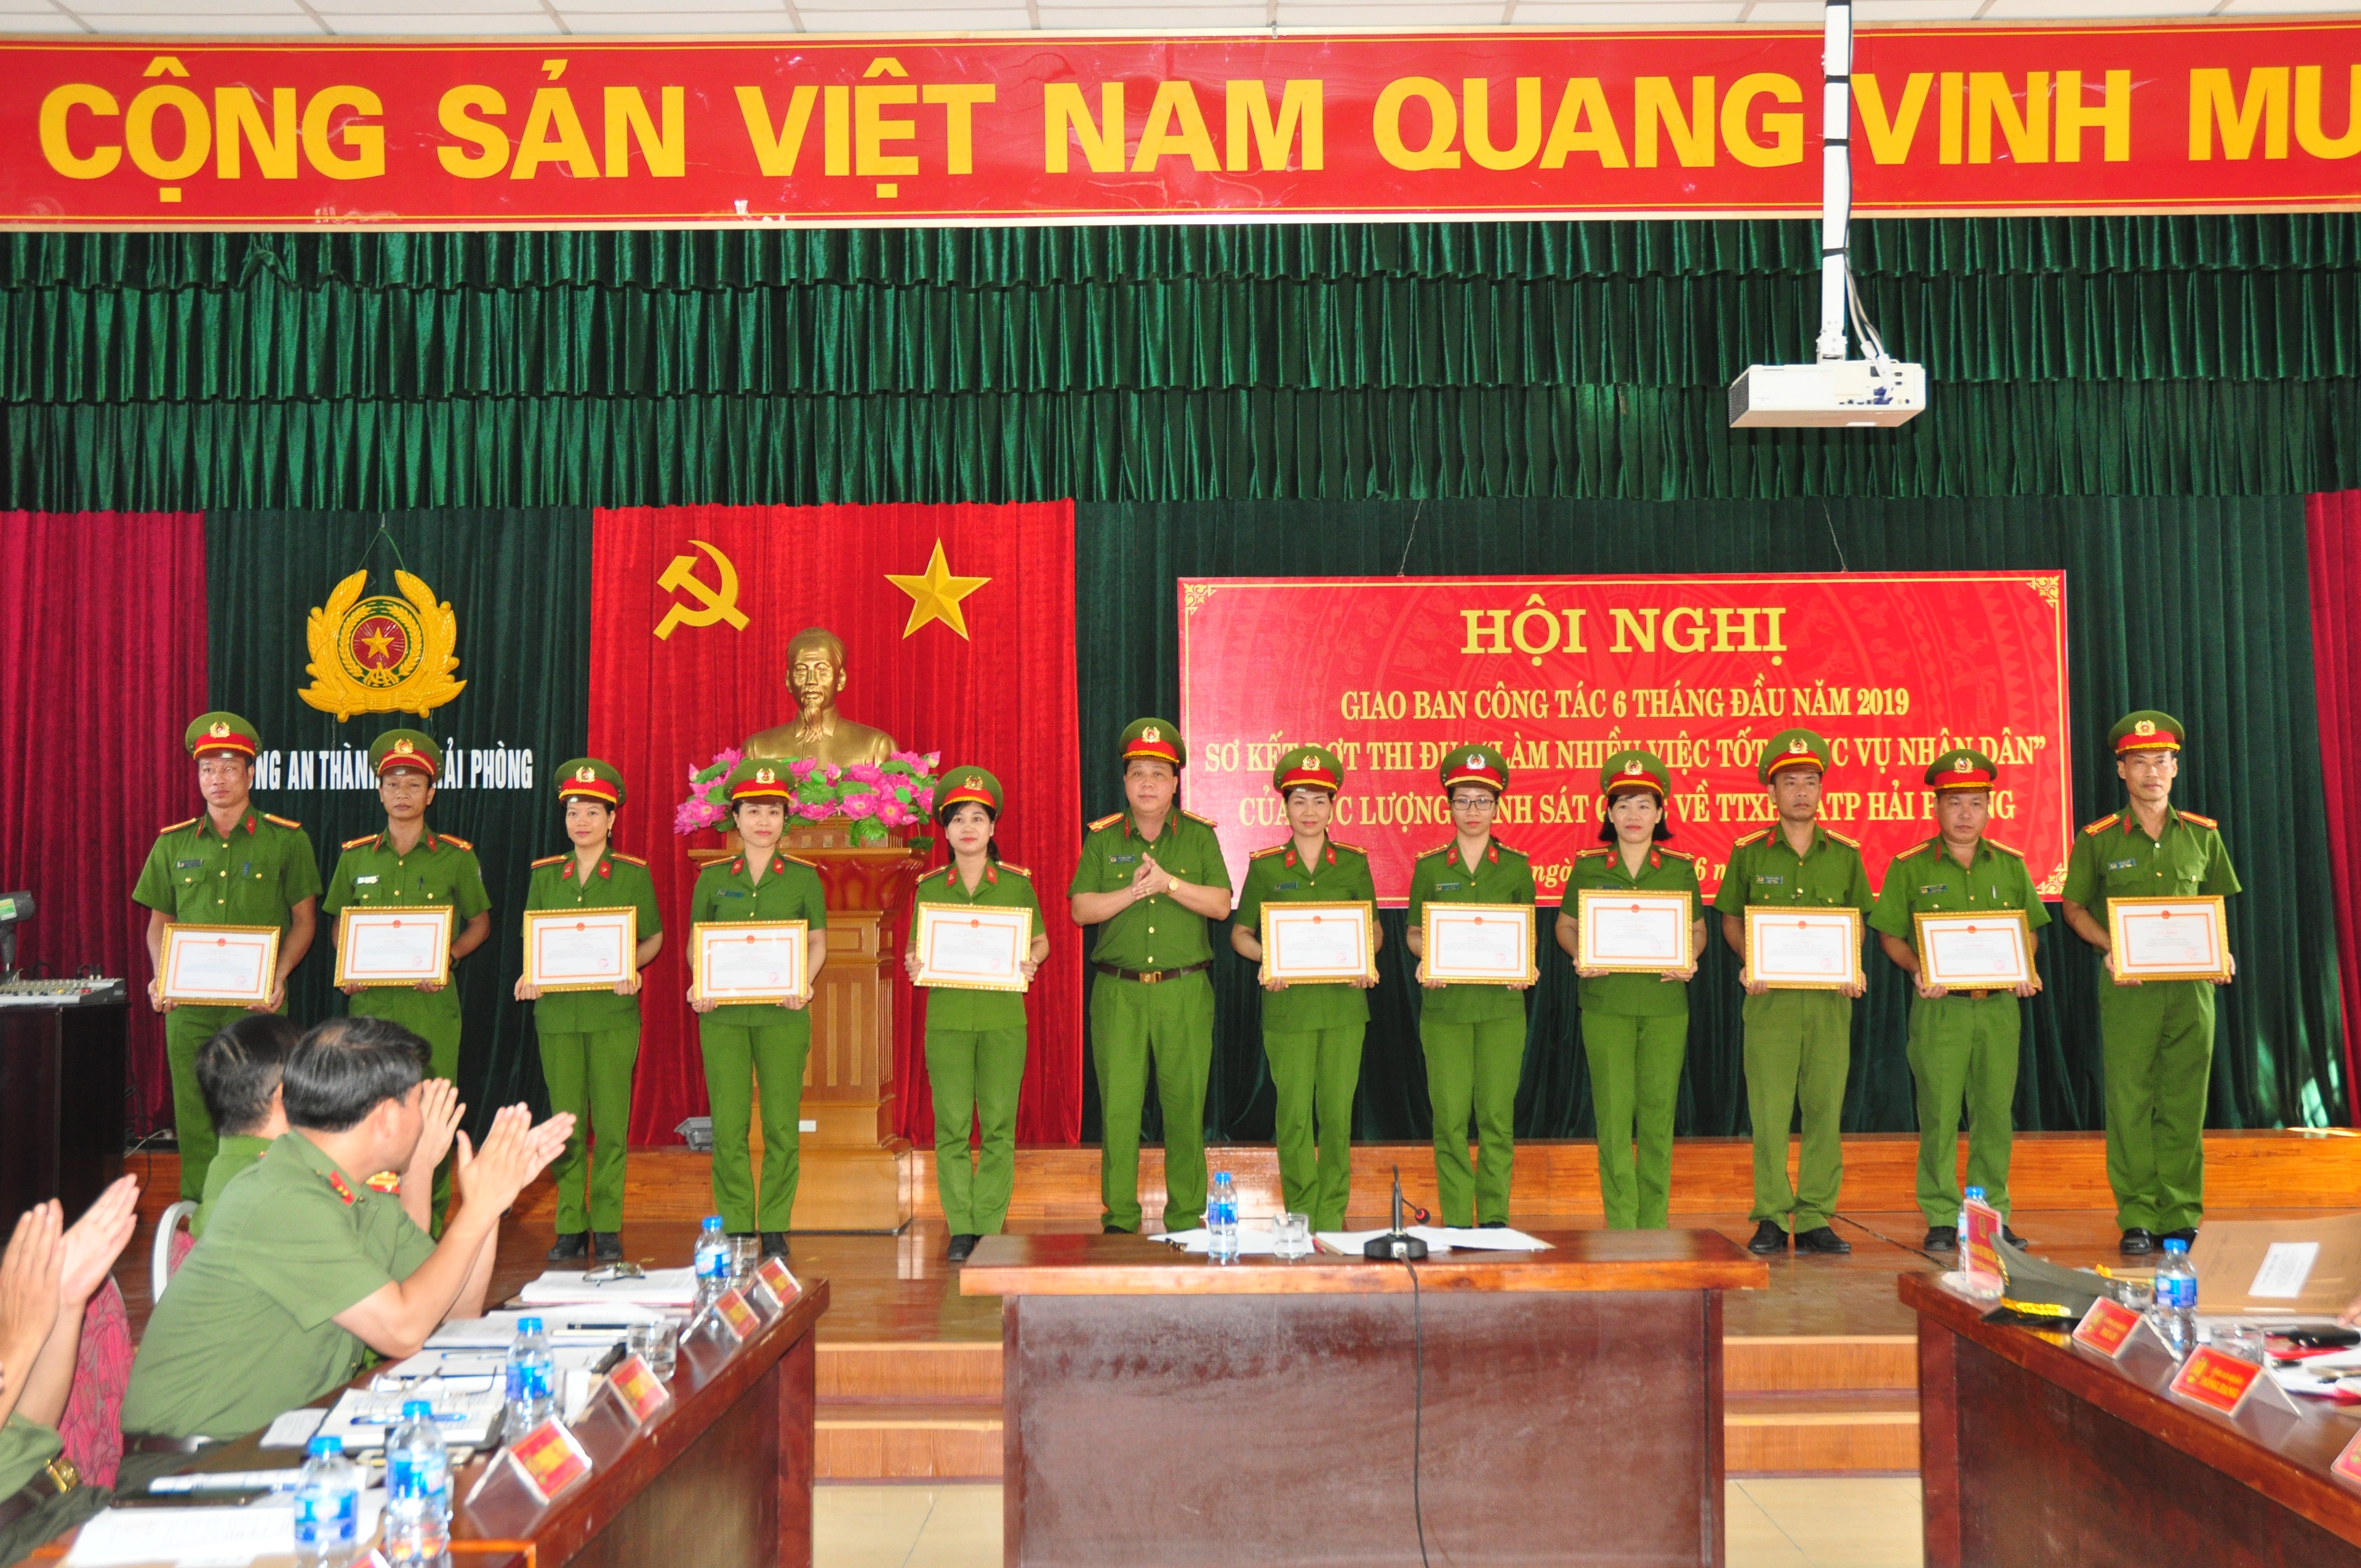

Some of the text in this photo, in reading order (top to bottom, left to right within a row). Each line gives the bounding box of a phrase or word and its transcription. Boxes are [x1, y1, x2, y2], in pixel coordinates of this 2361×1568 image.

[40, 57, 385, 202] CỘNG
[437, 59, 685, 179] SẢN
[734, 57, 995, 198] VIỆT
[1044, 79, 1323, 173] NAM
[1373, 73, 1803, 171] QUANG
[1849, 69, 2131, 165] VINH
[1460, 594, 1787, 666] HỘI NGHỊ
[1341, 673, 1910, 720] GIAO BAN CÔNG TÁC 6 THÁNG ĐẦU NĂM 2019
[287, 751, 314, 790] AN
[319, 742, 379, 790] THÀN
[471, 741, 533, 789] PHÒNG
[1205, 739, 1239, 772] SƠ
[1366, 742, 1414, 770] THI
[1646, 730, 1710, 776] VIỆC
[1853, 738, 1892, 774] VỤ
[1359, 791, 1452, 833] LƯỢNG
[1539, 786, 1589, 824] SÁT
[1673, 779, 1710, 823] VỀ
[1867, 779, 1915, 820] HẢI
